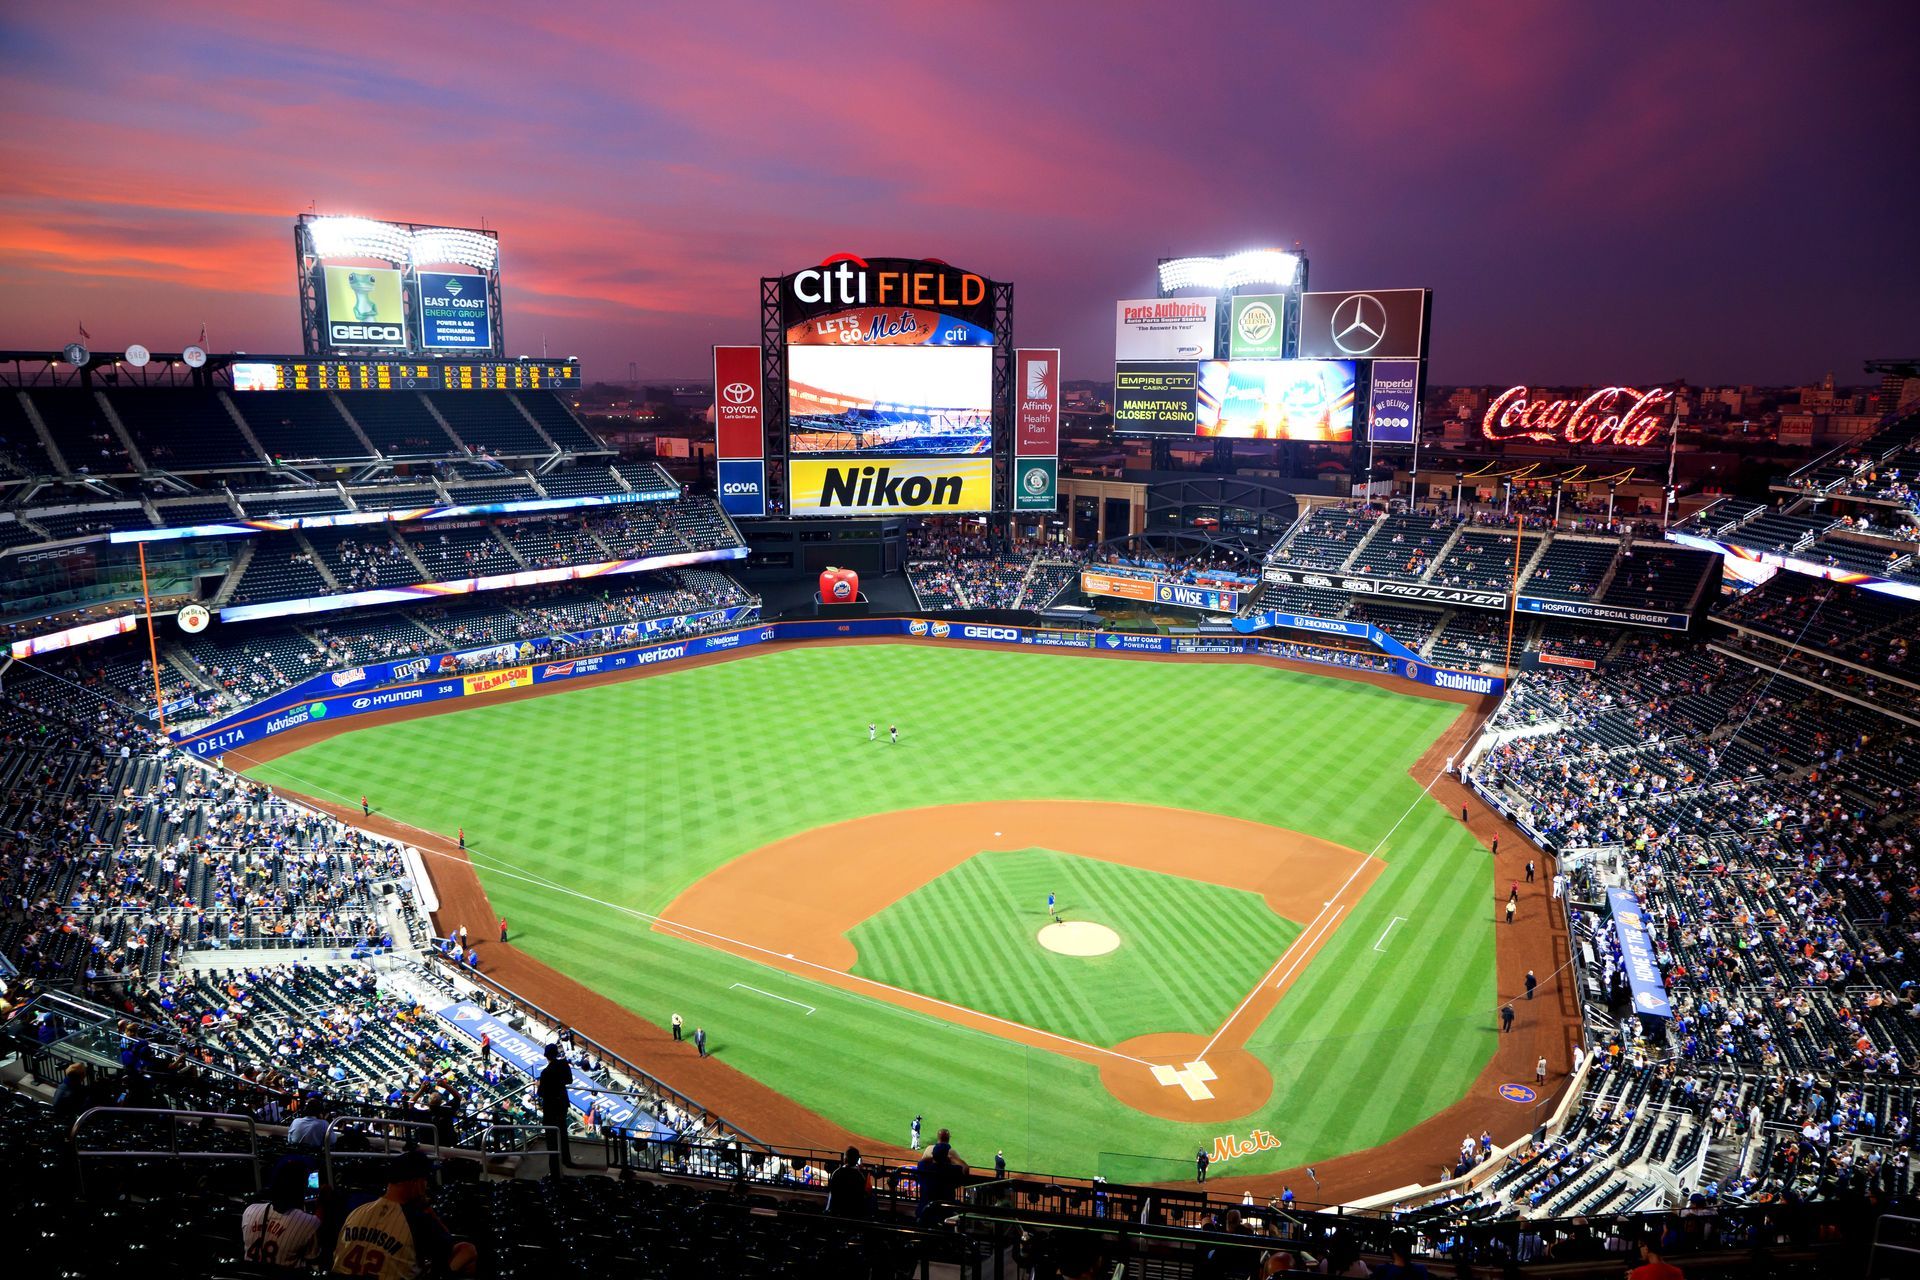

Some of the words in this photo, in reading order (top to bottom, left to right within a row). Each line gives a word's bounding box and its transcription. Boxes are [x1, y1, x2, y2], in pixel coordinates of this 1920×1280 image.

[794, 262, 866, 304] citi
[879, 272, 986, 306] FIELD
[424, 297, 450, 307] EAST
[452, 299, 485, 308] COAST
[1125, 306, 1153, 319] Parts
[1155, 302, 1206, 317] Authority
[425, 309, 456, 317] ENERGY
[458, 310, 485, 318] GROUP
[817, 315, 859, 335] LET'S
[840, 329, 862, 343] GO
[863, 311, 917, 342] Mets
[944, 328, 967, 341] citi
[1374, 379, 1413, 389] Imperial
[1022, 401, 1053, 412] Affinity
[1123, 400, 1187, 411] MANHATTAN'S
[1376, 401, 1386, 411] WE
[1386, 399, 1410, 412] DELIVER
[1024, 414, 1050, 422] Health
[1116, 410, 1157, 420] CLOSEST
[1159, 411, 1194, 421] CASINO
[1483, 386, 1674, 446] Coca-Cola
[1029, 424, 1046, 433] Plan
[723, 482, 758, 494] GOYA
[819, 466, 963, 507] Nikon
[17, 546, 87, 564] PORSCHE
[1379, 584, 1422, 596] PRO
[1422, 589, 1505, 605] PLAYER
[1542, 603, 1577, 614] HOSPITAL
[1578, 607, 1593, 615] FOR
[1594, 608, 1628, 619] SPECIAL
[1629, 613, 1669, 624] SURGERY
[964, 626, 1018, 640] GEICO
[1304, 620, 1348, 631] HONDA
[713, 634, 739, 645] National
[761, 630, 774, 640] citi
[638, 646, 684, 664] verizon
[438, 686, 453, 694] 358
[1435, 671, 1492, 694] StubHub!
[373, 689, 423, 705] HYUNDAI
[289, 705, 307, 715] BLOCK
[266, 712, 309, 734] Advisors
[198, 729, 244, 754] DELTA
[1624, 928, 1644, 944] THE
[1629, 944, 1648, 956] OF
[1632, 956, 1655, 982] HOME
[476, 1021, 545, 1066] WELCOME
[1207, 1129, 1282, 1163] Mets
[344, 1226, 403, 1255] ROBINSON
[343, 1244, 386, 1276] 42
